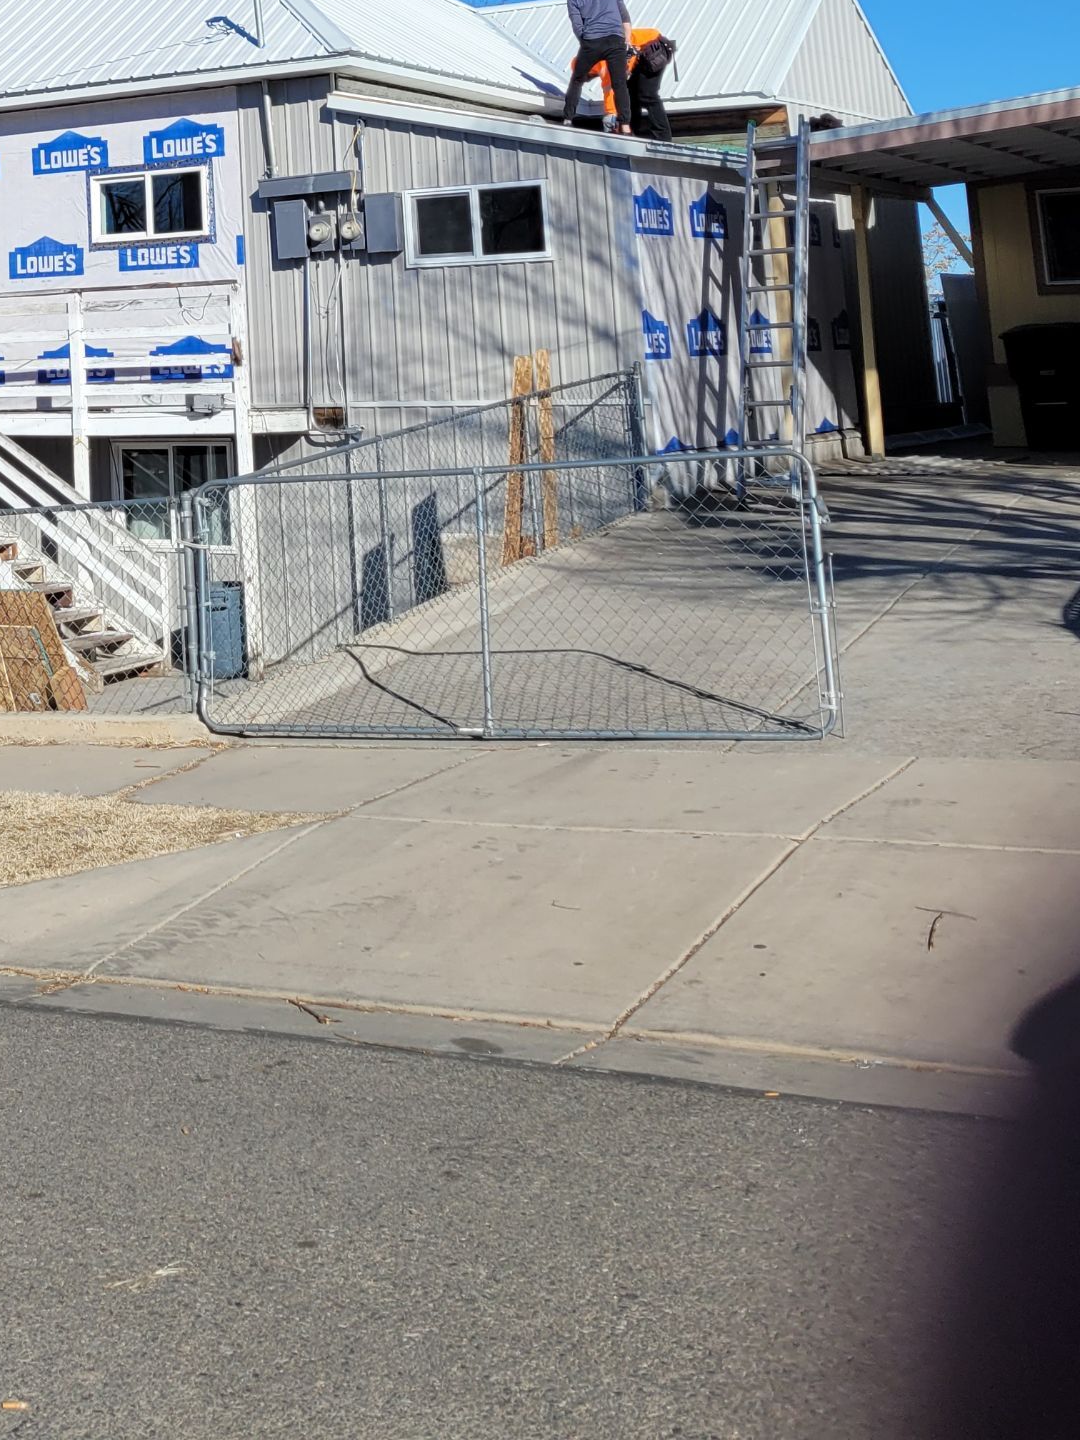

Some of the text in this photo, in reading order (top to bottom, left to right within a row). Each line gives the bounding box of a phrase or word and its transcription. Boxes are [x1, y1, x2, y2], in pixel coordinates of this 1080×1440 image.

[40, 144, 101, 170] LOWE'S
[152, 131, 217, 158] LOWE'S
[635, 203, 669, 230] LOWE'S
[16, 251, 77, 275] LOWE'S
[126, 244, 191, 267] LOWE'S
